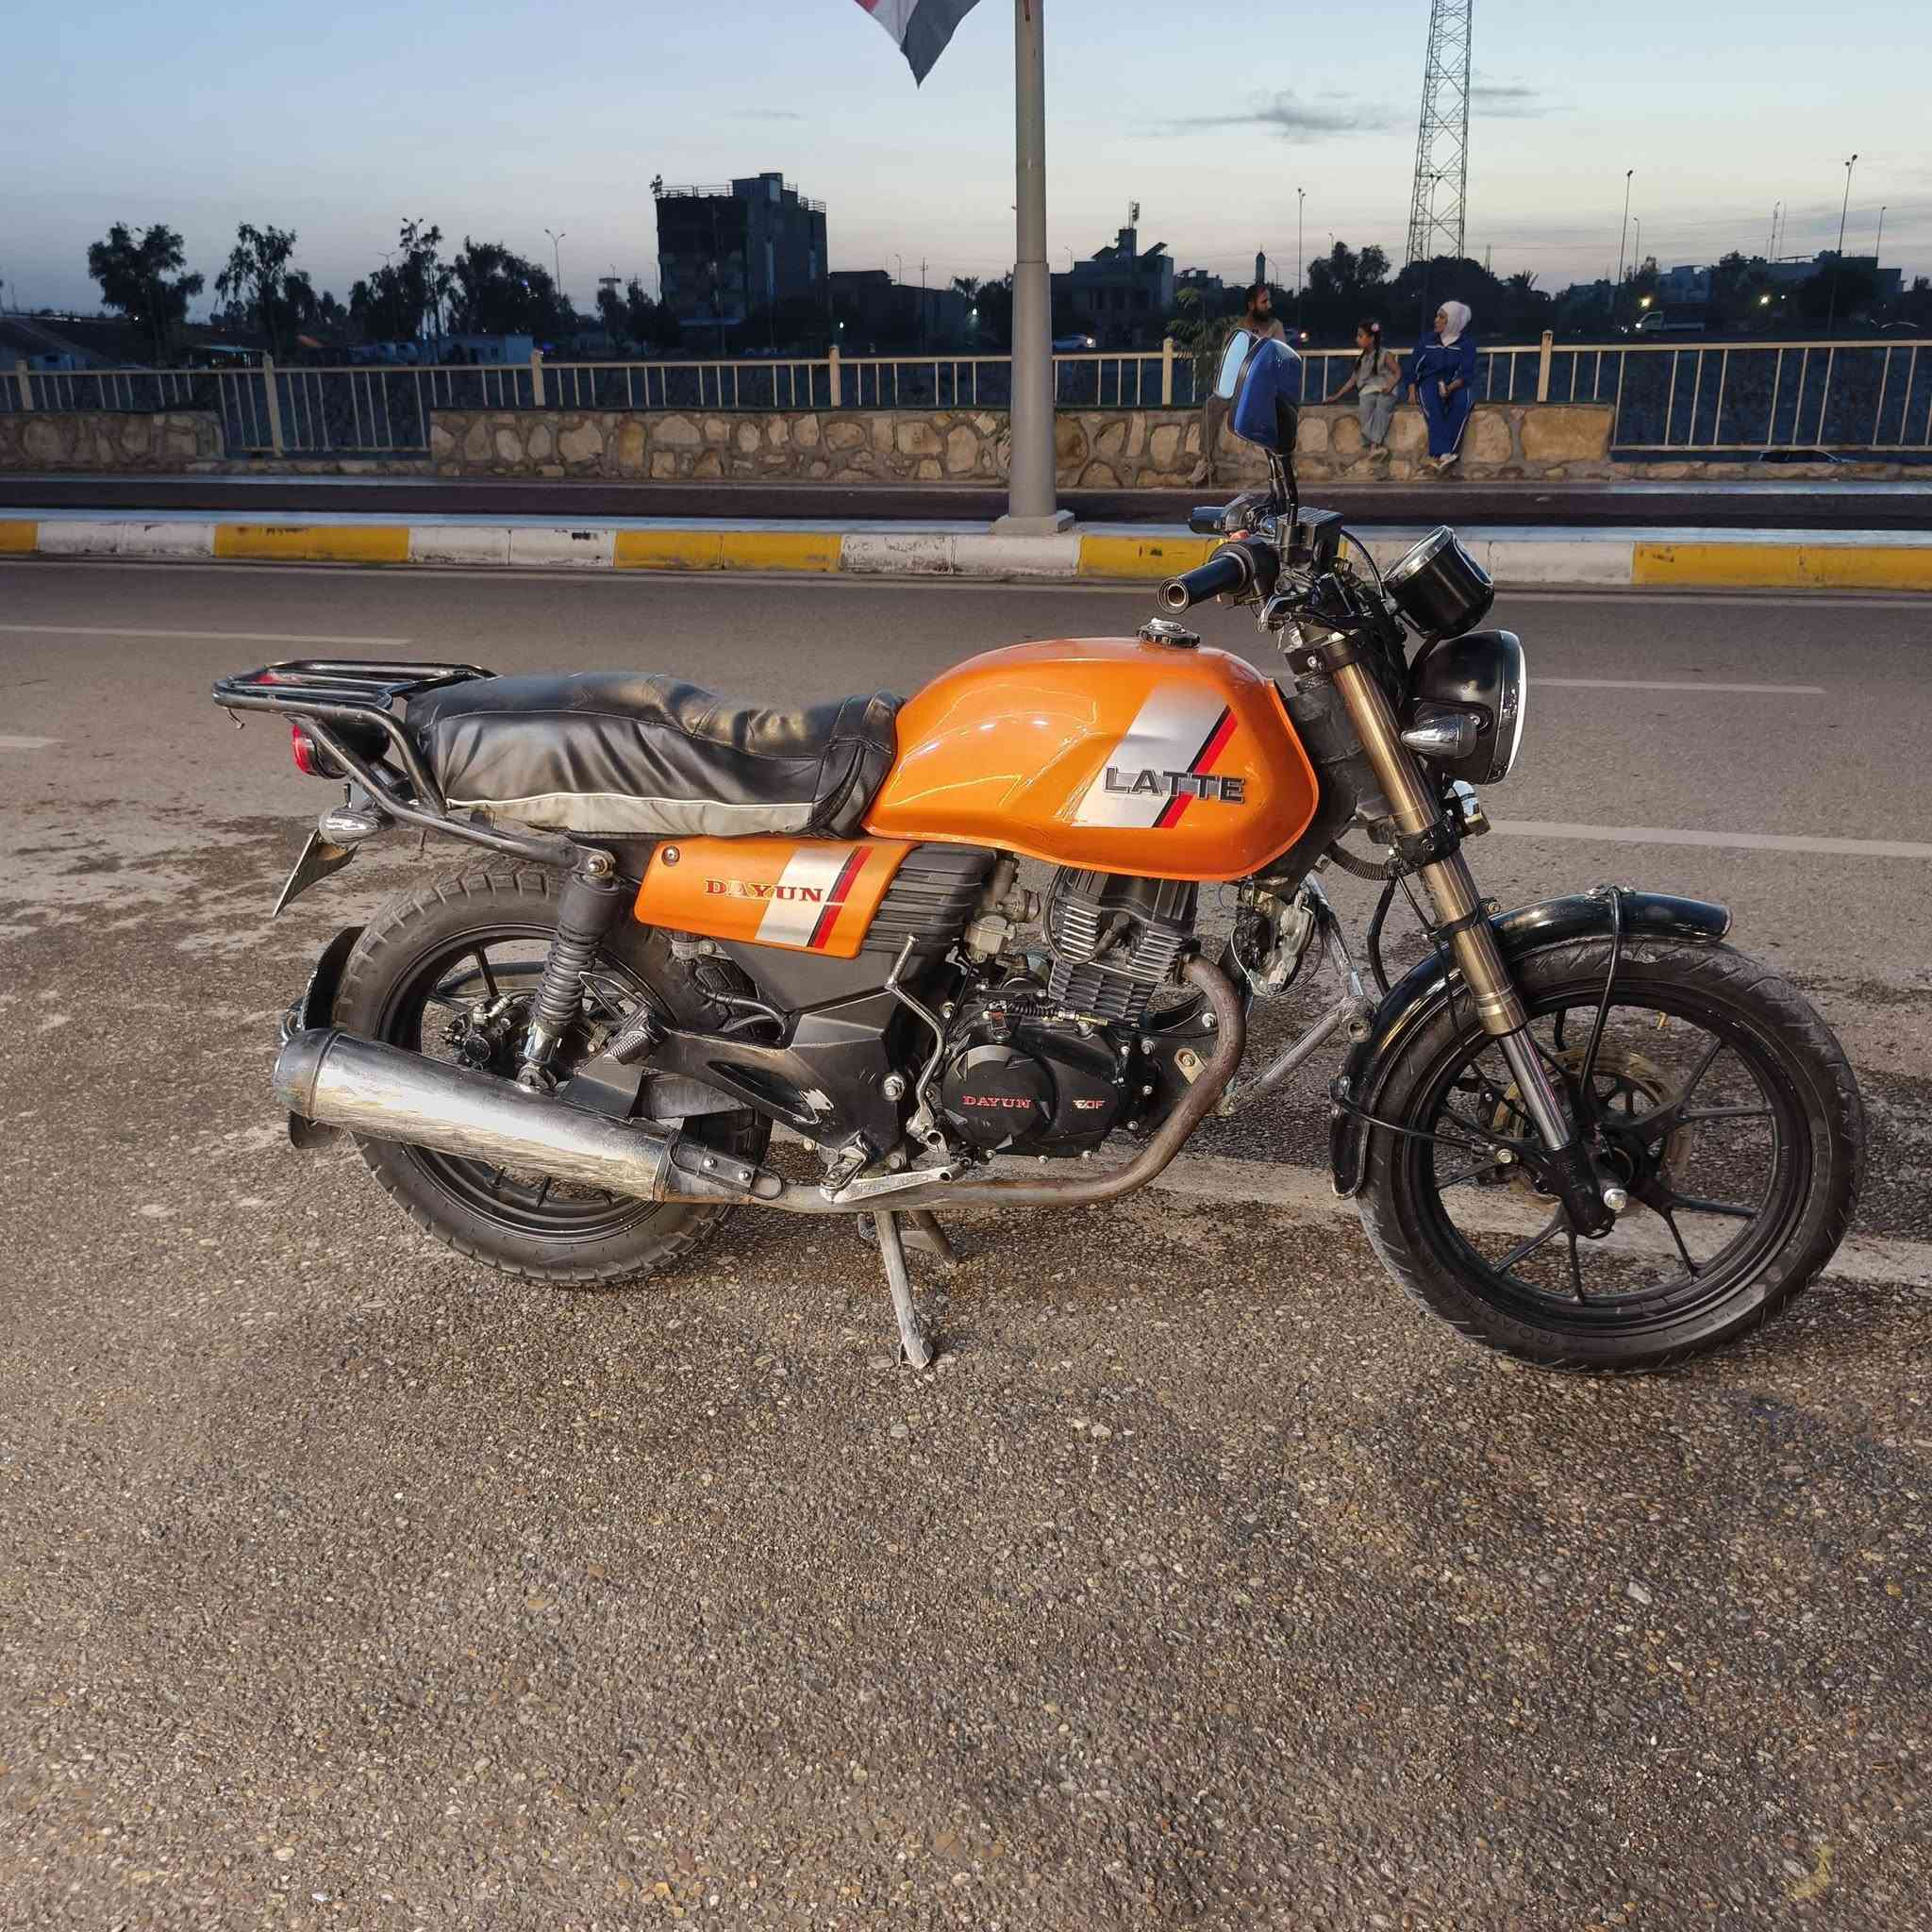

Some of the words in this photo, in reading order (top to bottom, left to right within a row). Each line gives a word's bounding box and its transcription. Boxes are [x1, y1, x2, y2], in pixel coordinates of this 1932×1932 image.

[1105, 766, 1246, 804] LATTE
[705, 879, 824, 902] DAYUN
[962, 1094, 1031, 1109] DAYUN
